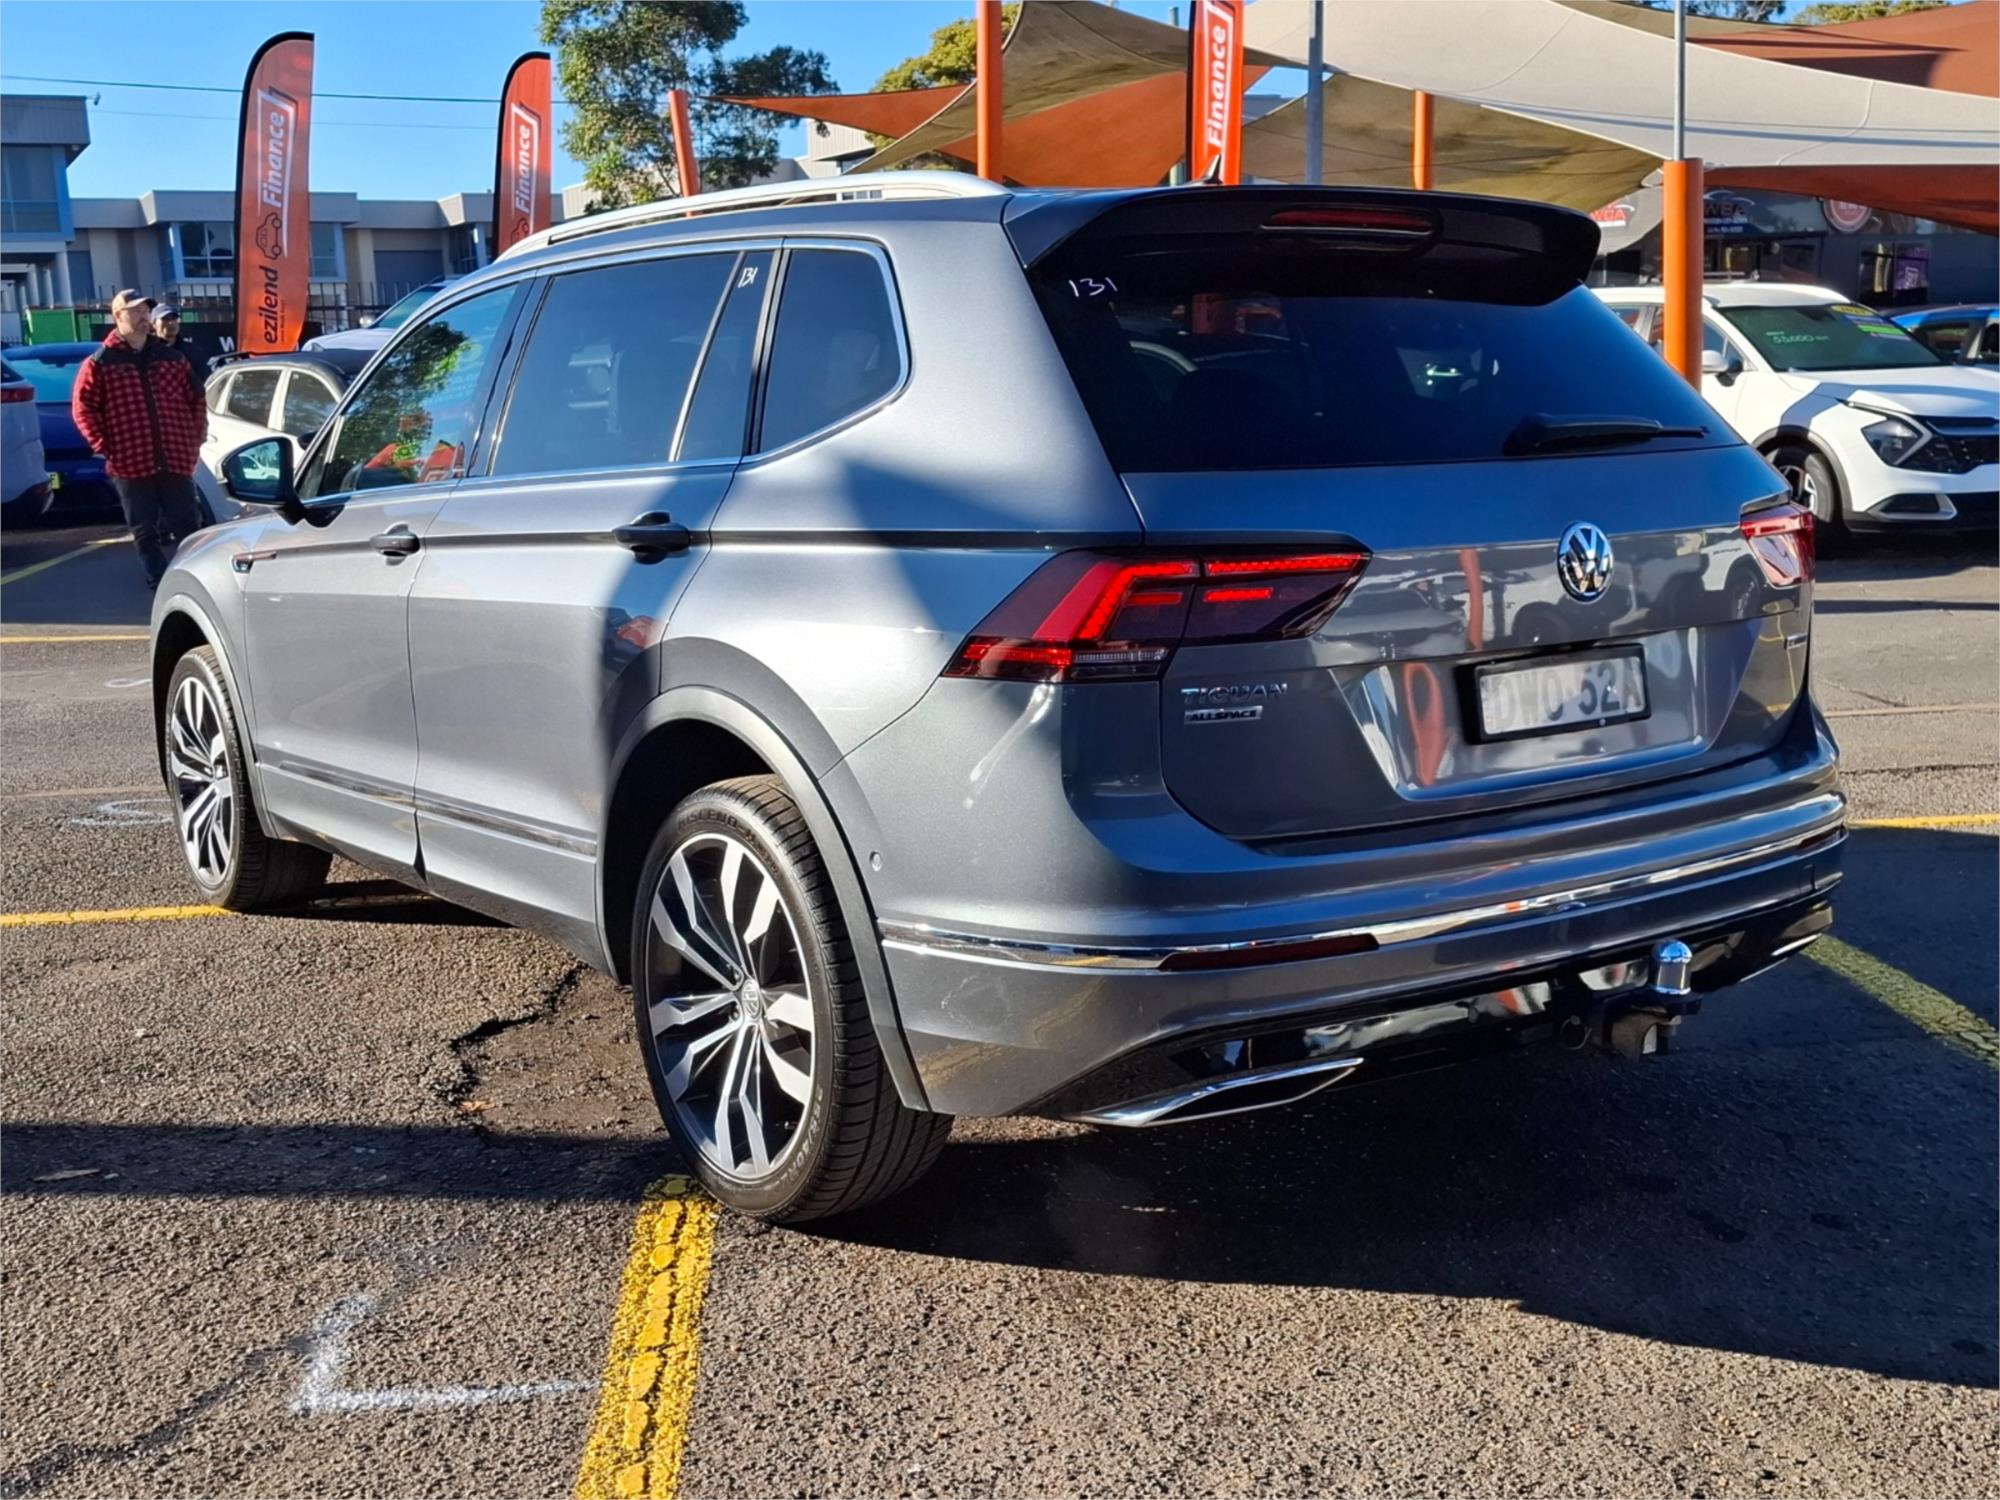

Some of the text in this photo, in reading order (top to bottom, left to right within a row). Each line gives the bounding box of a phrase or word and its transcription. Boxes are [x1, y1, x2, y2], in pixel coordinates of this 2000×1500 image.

[1207, 25, 1226, 147] Finance
[262, 111, 285, 208] Finance
[515, 124, 531, 214] Finance
[258, 264, 279, 344] ezilend
[1069, 276, 1118, 297] 131
[1180, 683, 1287, 704] TIGUAN
[1188, 708, 1258, 721] ALLSPACE
